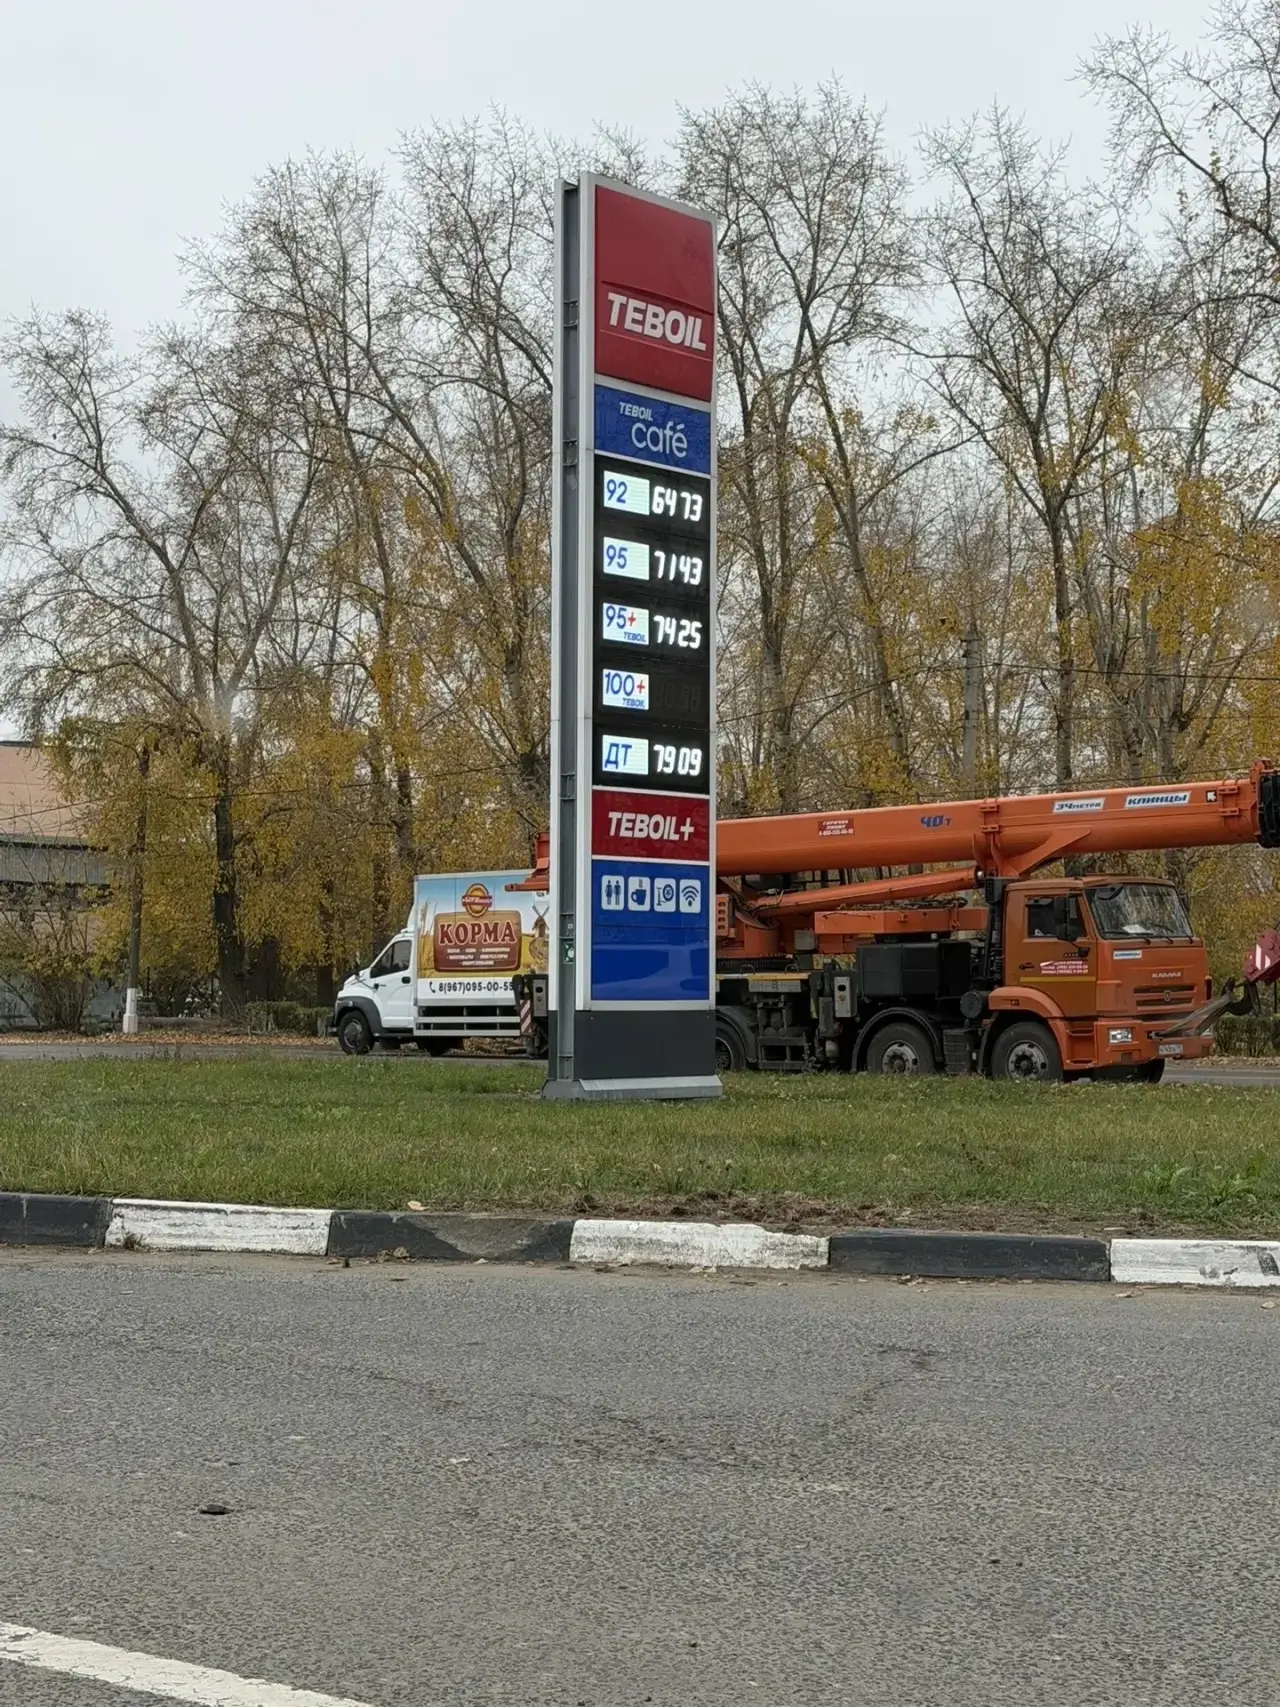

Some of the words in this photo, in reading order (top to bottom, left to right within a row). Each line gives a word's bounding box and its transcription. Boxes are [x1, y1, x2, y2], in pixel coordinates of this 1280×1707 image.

[608, 292, 707, 351] TEBOIL
[619, 401, 653, 421] TEBOIL
[631, 421, 688, 458] café
[606, 479, 627, 504] 92
[606, 544, 628, 569] 95
[606, 605, 637, 630] 95+
[623, 631, 646, 643] TEBOIL
[605, 671, 646, 696] 100+
[605, 743, 632, 769] ДТ
[1127, 794, 1188, 806] КЛИНЦЫ
[608, 811, 695, 842] TEBOIL+
[439, 920, 517, 945] КОРМА
